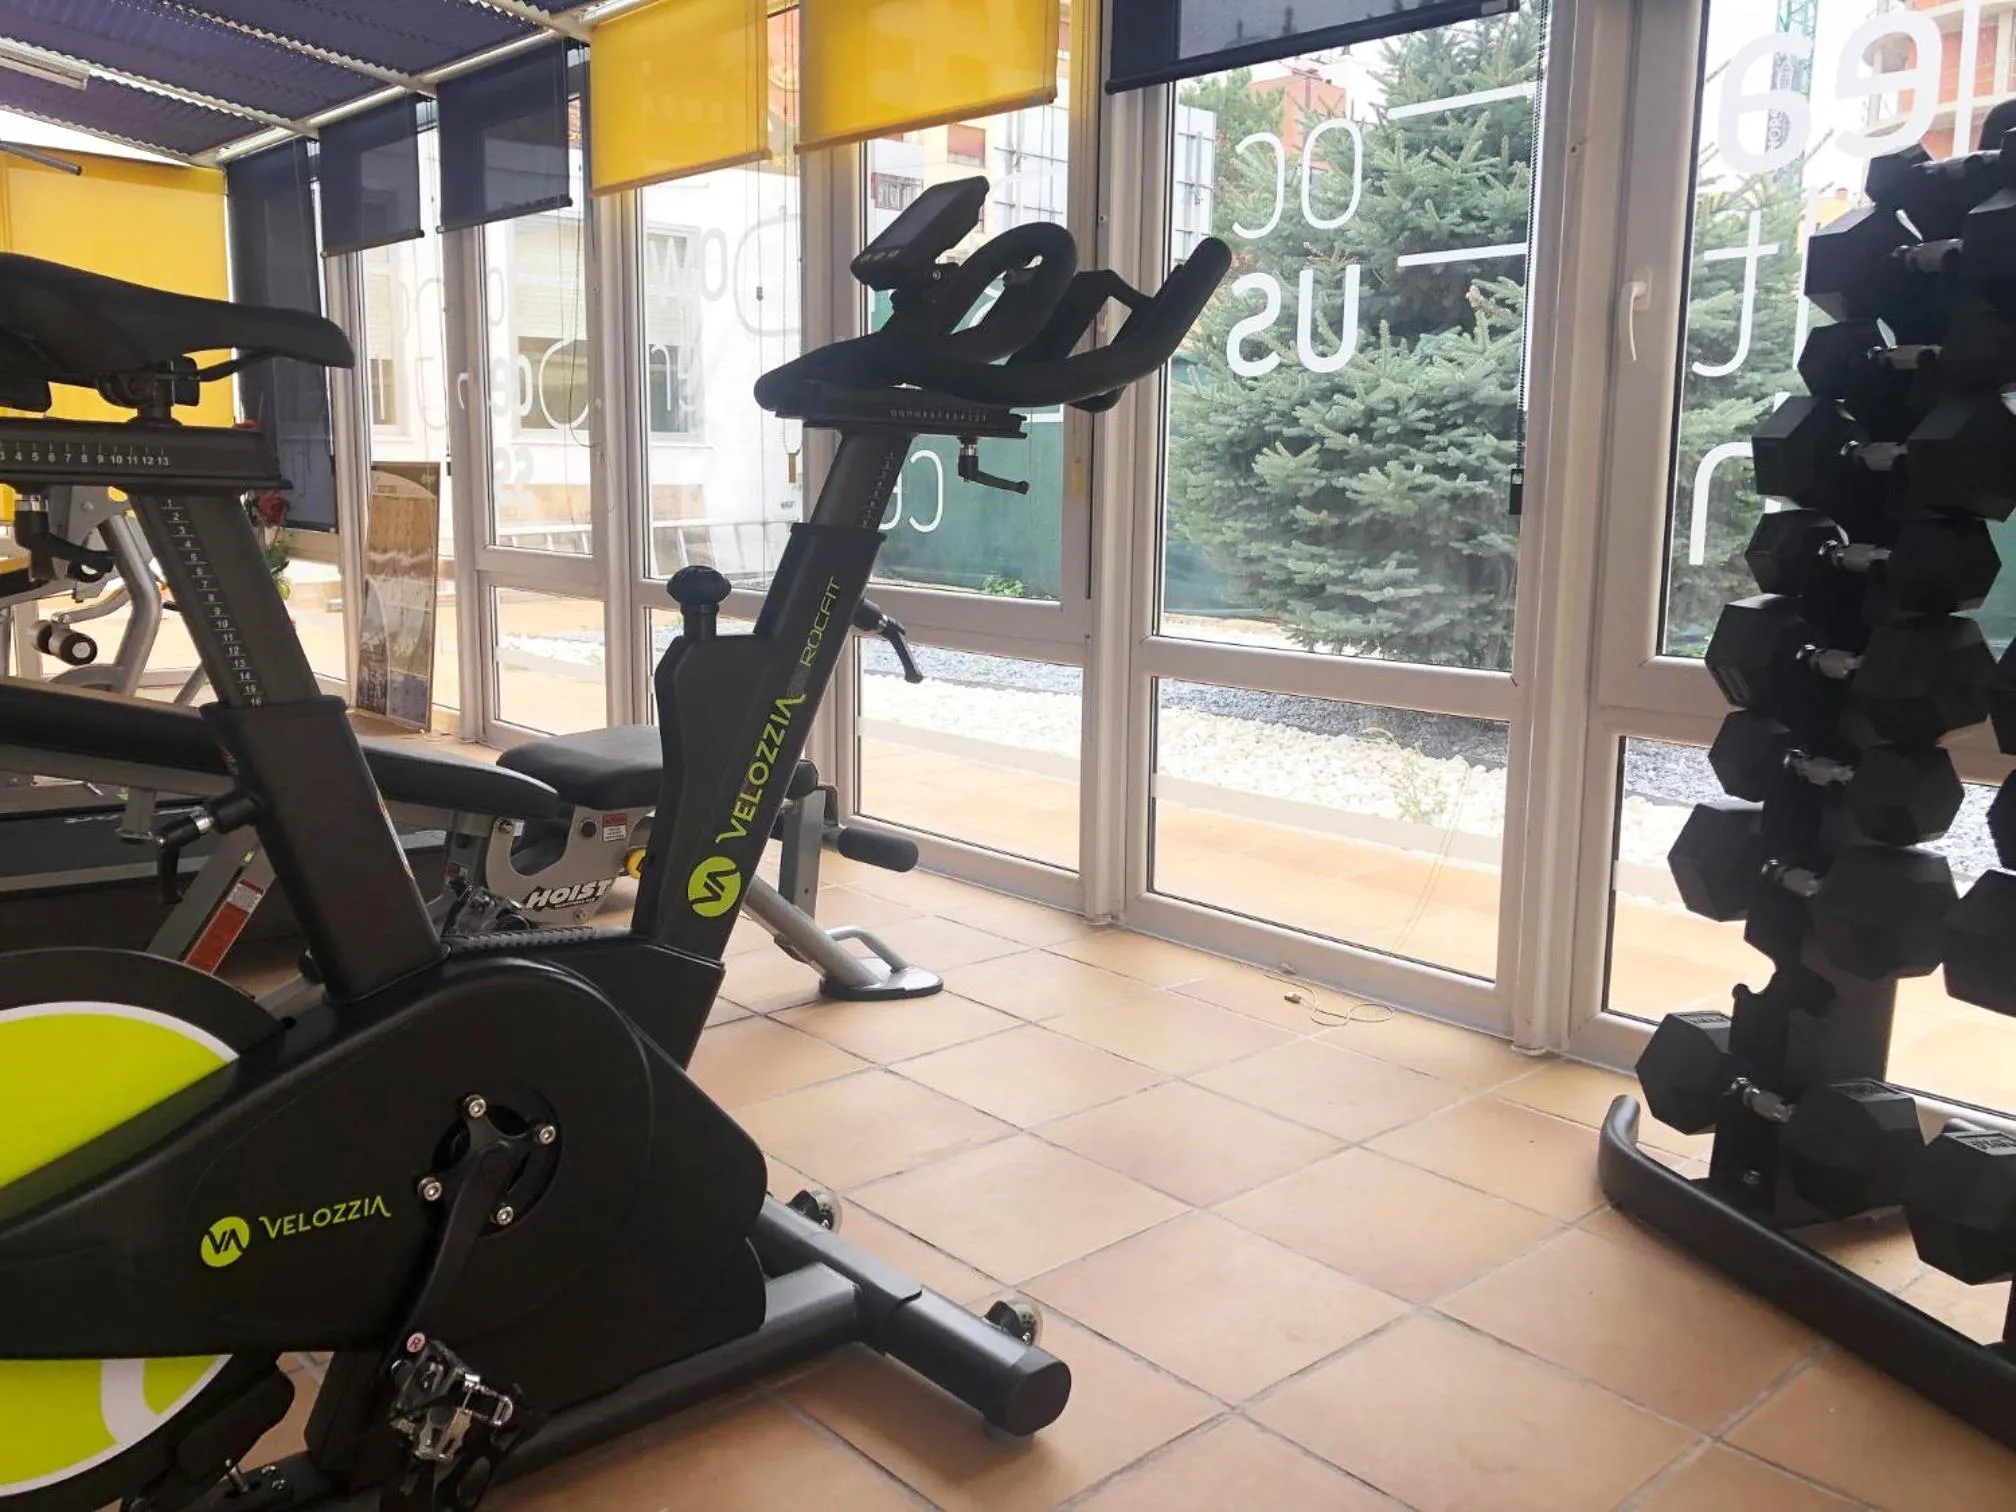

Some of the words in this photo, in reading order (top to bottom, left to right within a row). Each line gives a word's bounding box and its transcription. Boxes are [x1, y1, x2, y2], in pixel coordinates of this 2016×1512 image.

[15, 453, 22, 461] 4
[32, 453, 39, 462] 5
[65, 454, 72, 462] 7
[81, 454, 88, 463] 8
[111, 455, 122, 464] 10
[127, 456, 138, 465] 11
[142, 456, 153, 465] 12
[157, 456, 169, 466] 13
[217, 620, 228, 628] 10
[799, 574, 843, 667] ROCFIT
[229, 646, 240, 655] 12
[234, 660, 246, 668] 13
[240, 672, 251, 681] 14
[714, 691, 807, 845] VELOZZIA
[525, 878, 614, 911] HOIST
[258, 1195, 392, 1239] VELOZZIA
[408, 1335, 423, 1351] R
